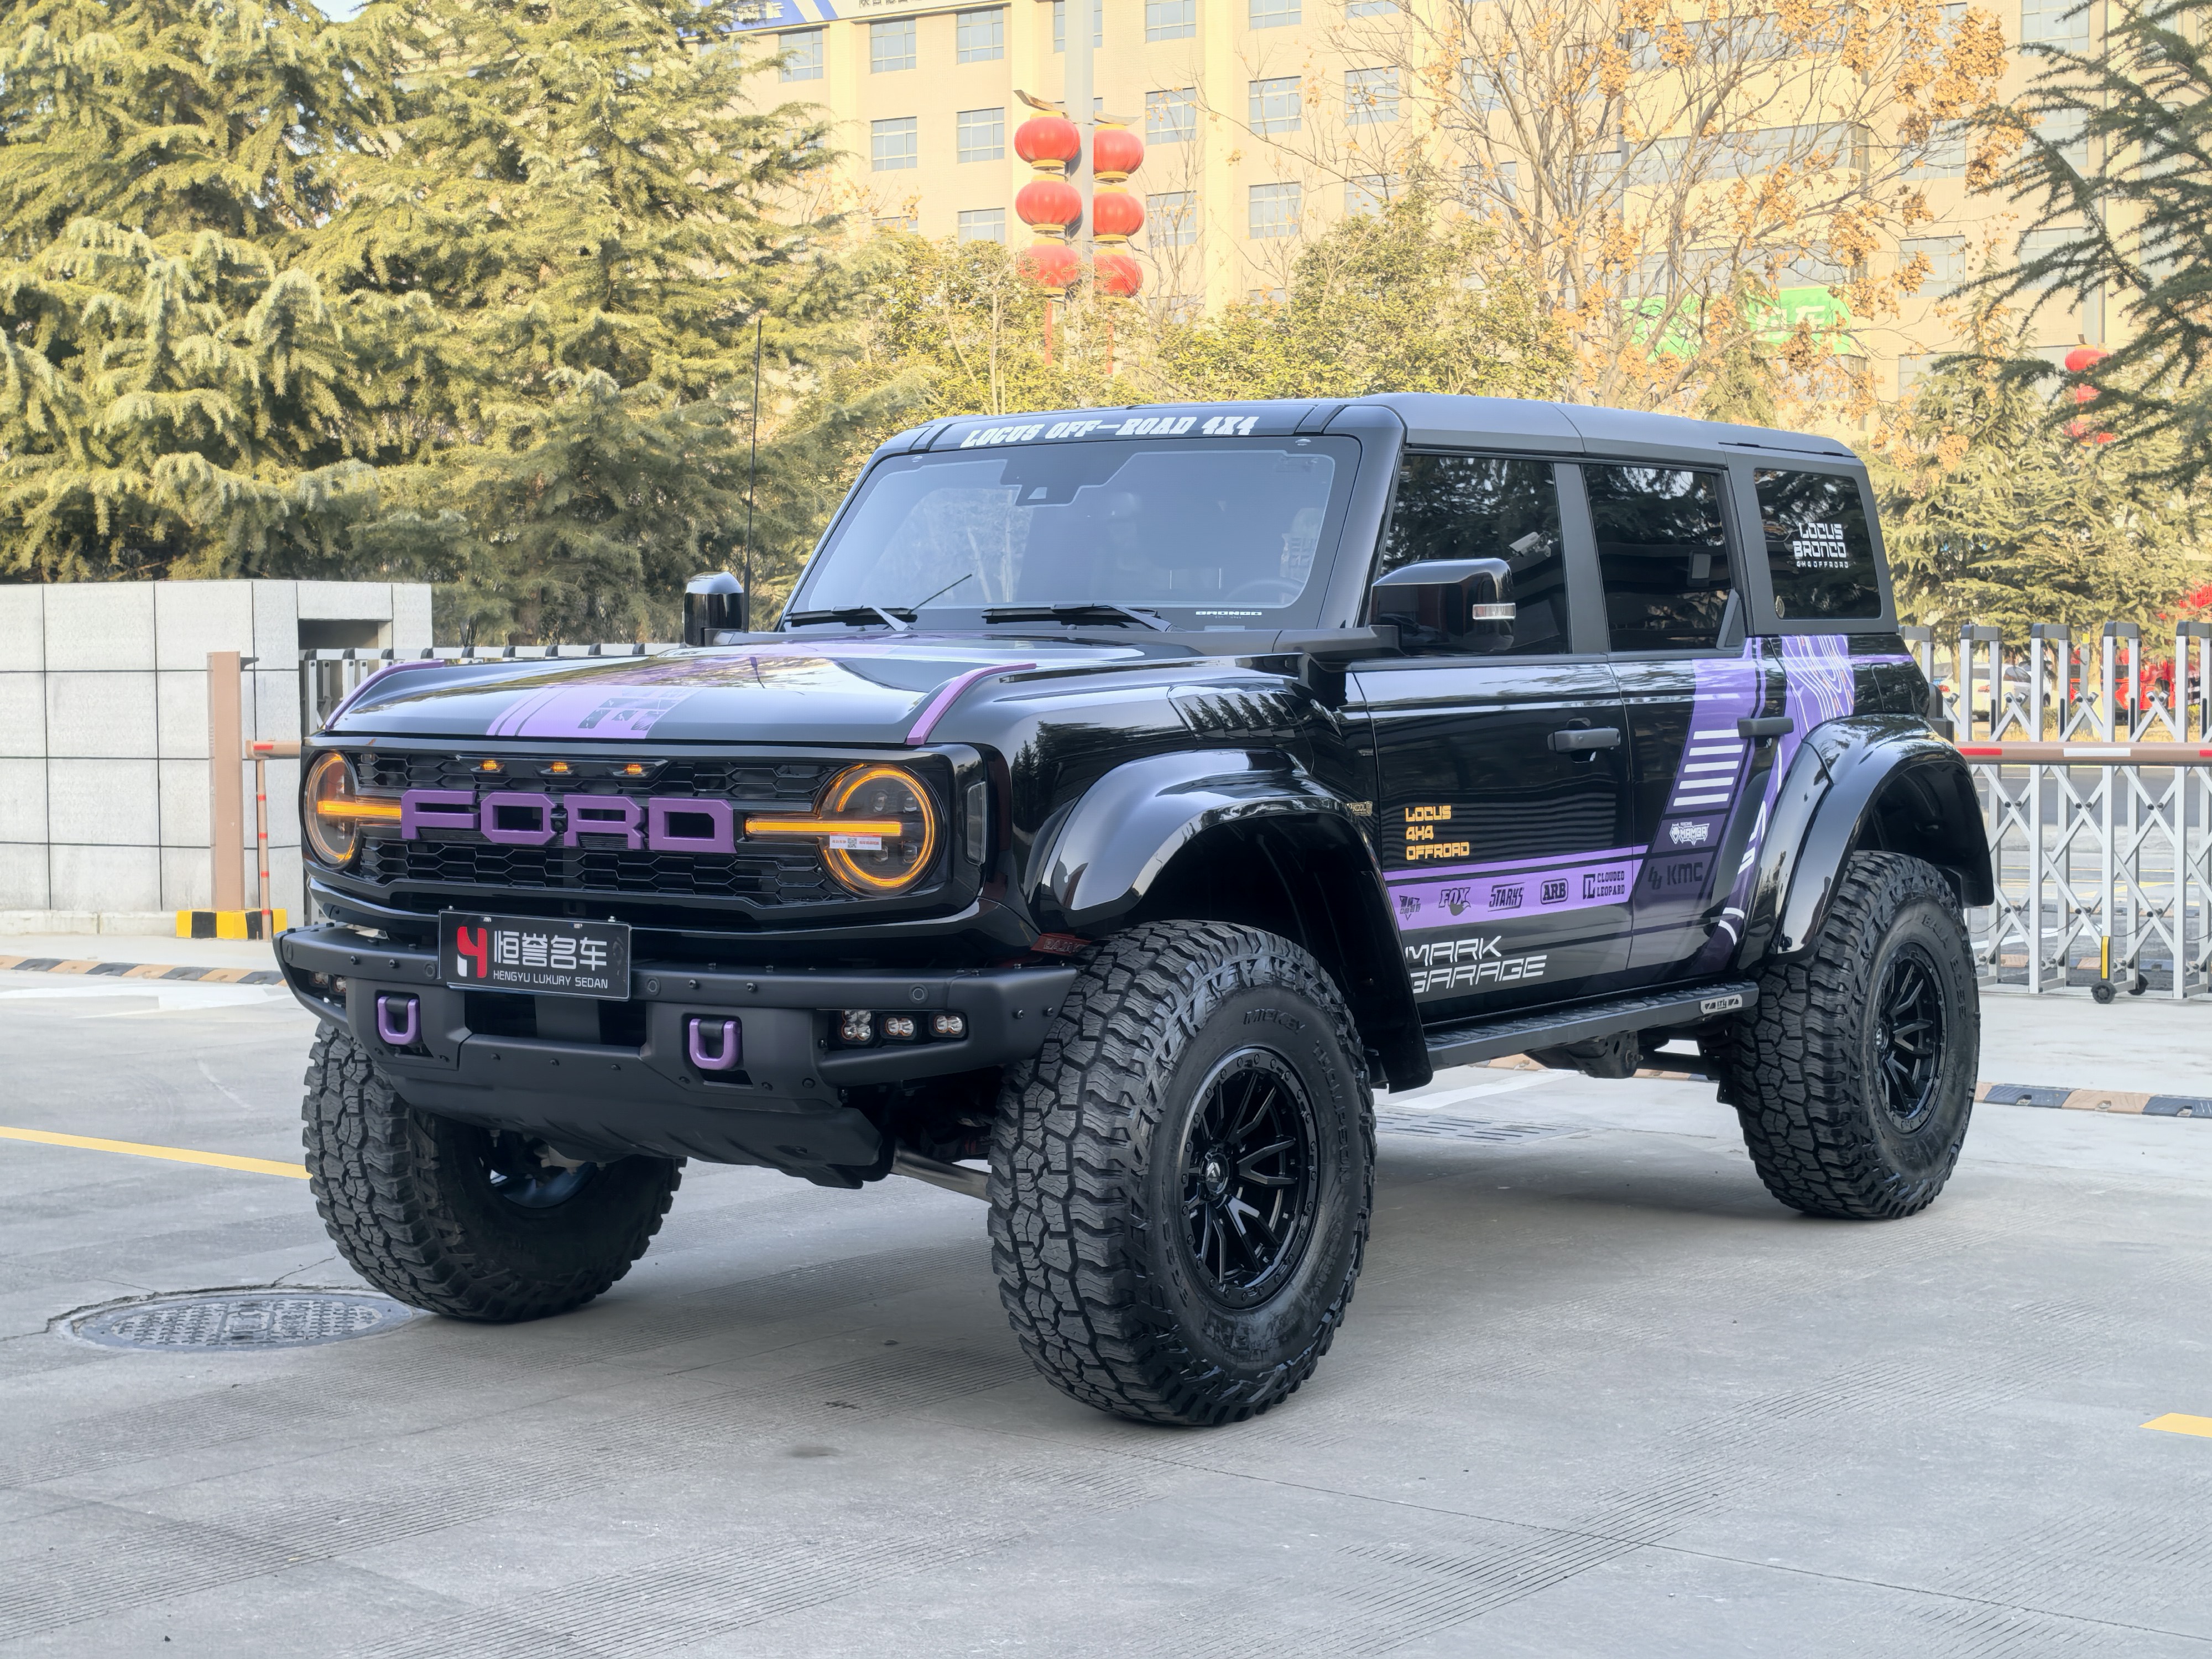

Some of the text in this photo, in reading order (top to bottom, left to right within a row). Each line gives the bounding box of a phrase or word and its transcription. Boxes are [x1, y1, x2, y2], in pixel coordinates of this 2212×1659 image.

[960, 416, 1259, 448] LOCUS OFF-ROAD 4X4
[1798, 523, 1843, 540] LOCUS
[1792, 541, 1846, 559] BRONCO
[401, 789, 737, 854] FORD
[1405, 805, 1452, 822] LOCUS
[1406, 842, 1470, 860] OFFROAD
[1667, 862, 1703, 885] KMC
[1439, 887, 1471, 908] FOX
[1542, 882, 1567, 901] ARB
[1597, 884, 1625, 897] LEOPARD
[494, 930, 607, 971] 恒誉名车
[1405, 935, 1502, 967] MARK
[493, 969, 608, 989] HENGYU LUXURY SEDAN
[1410, 954, 1547, 994] GARAGE
